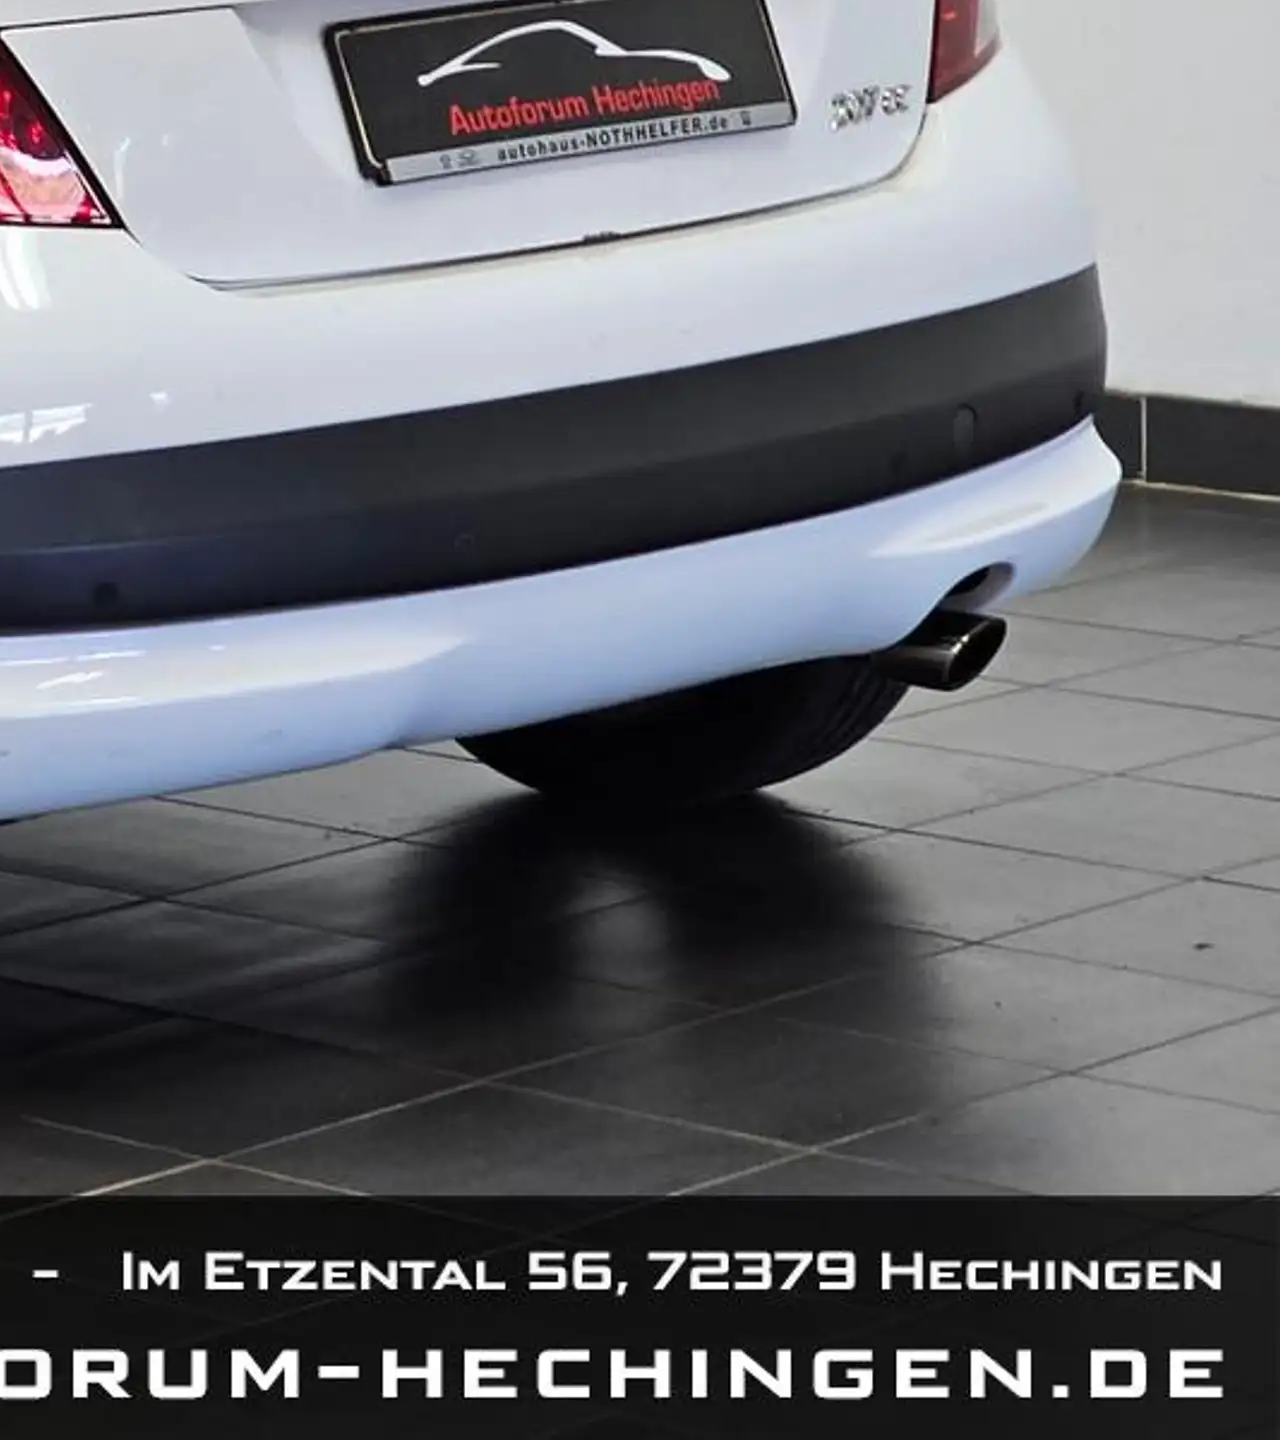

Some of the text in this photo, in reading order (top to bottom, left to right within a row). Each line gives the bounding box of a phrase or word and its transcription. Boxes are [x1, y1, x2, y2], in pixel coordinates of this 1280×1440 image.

[449, 77, 721, 136] Autoforum Hechingen
[496, 114, 729, 163] autohaus-NOTHHELFER.de
